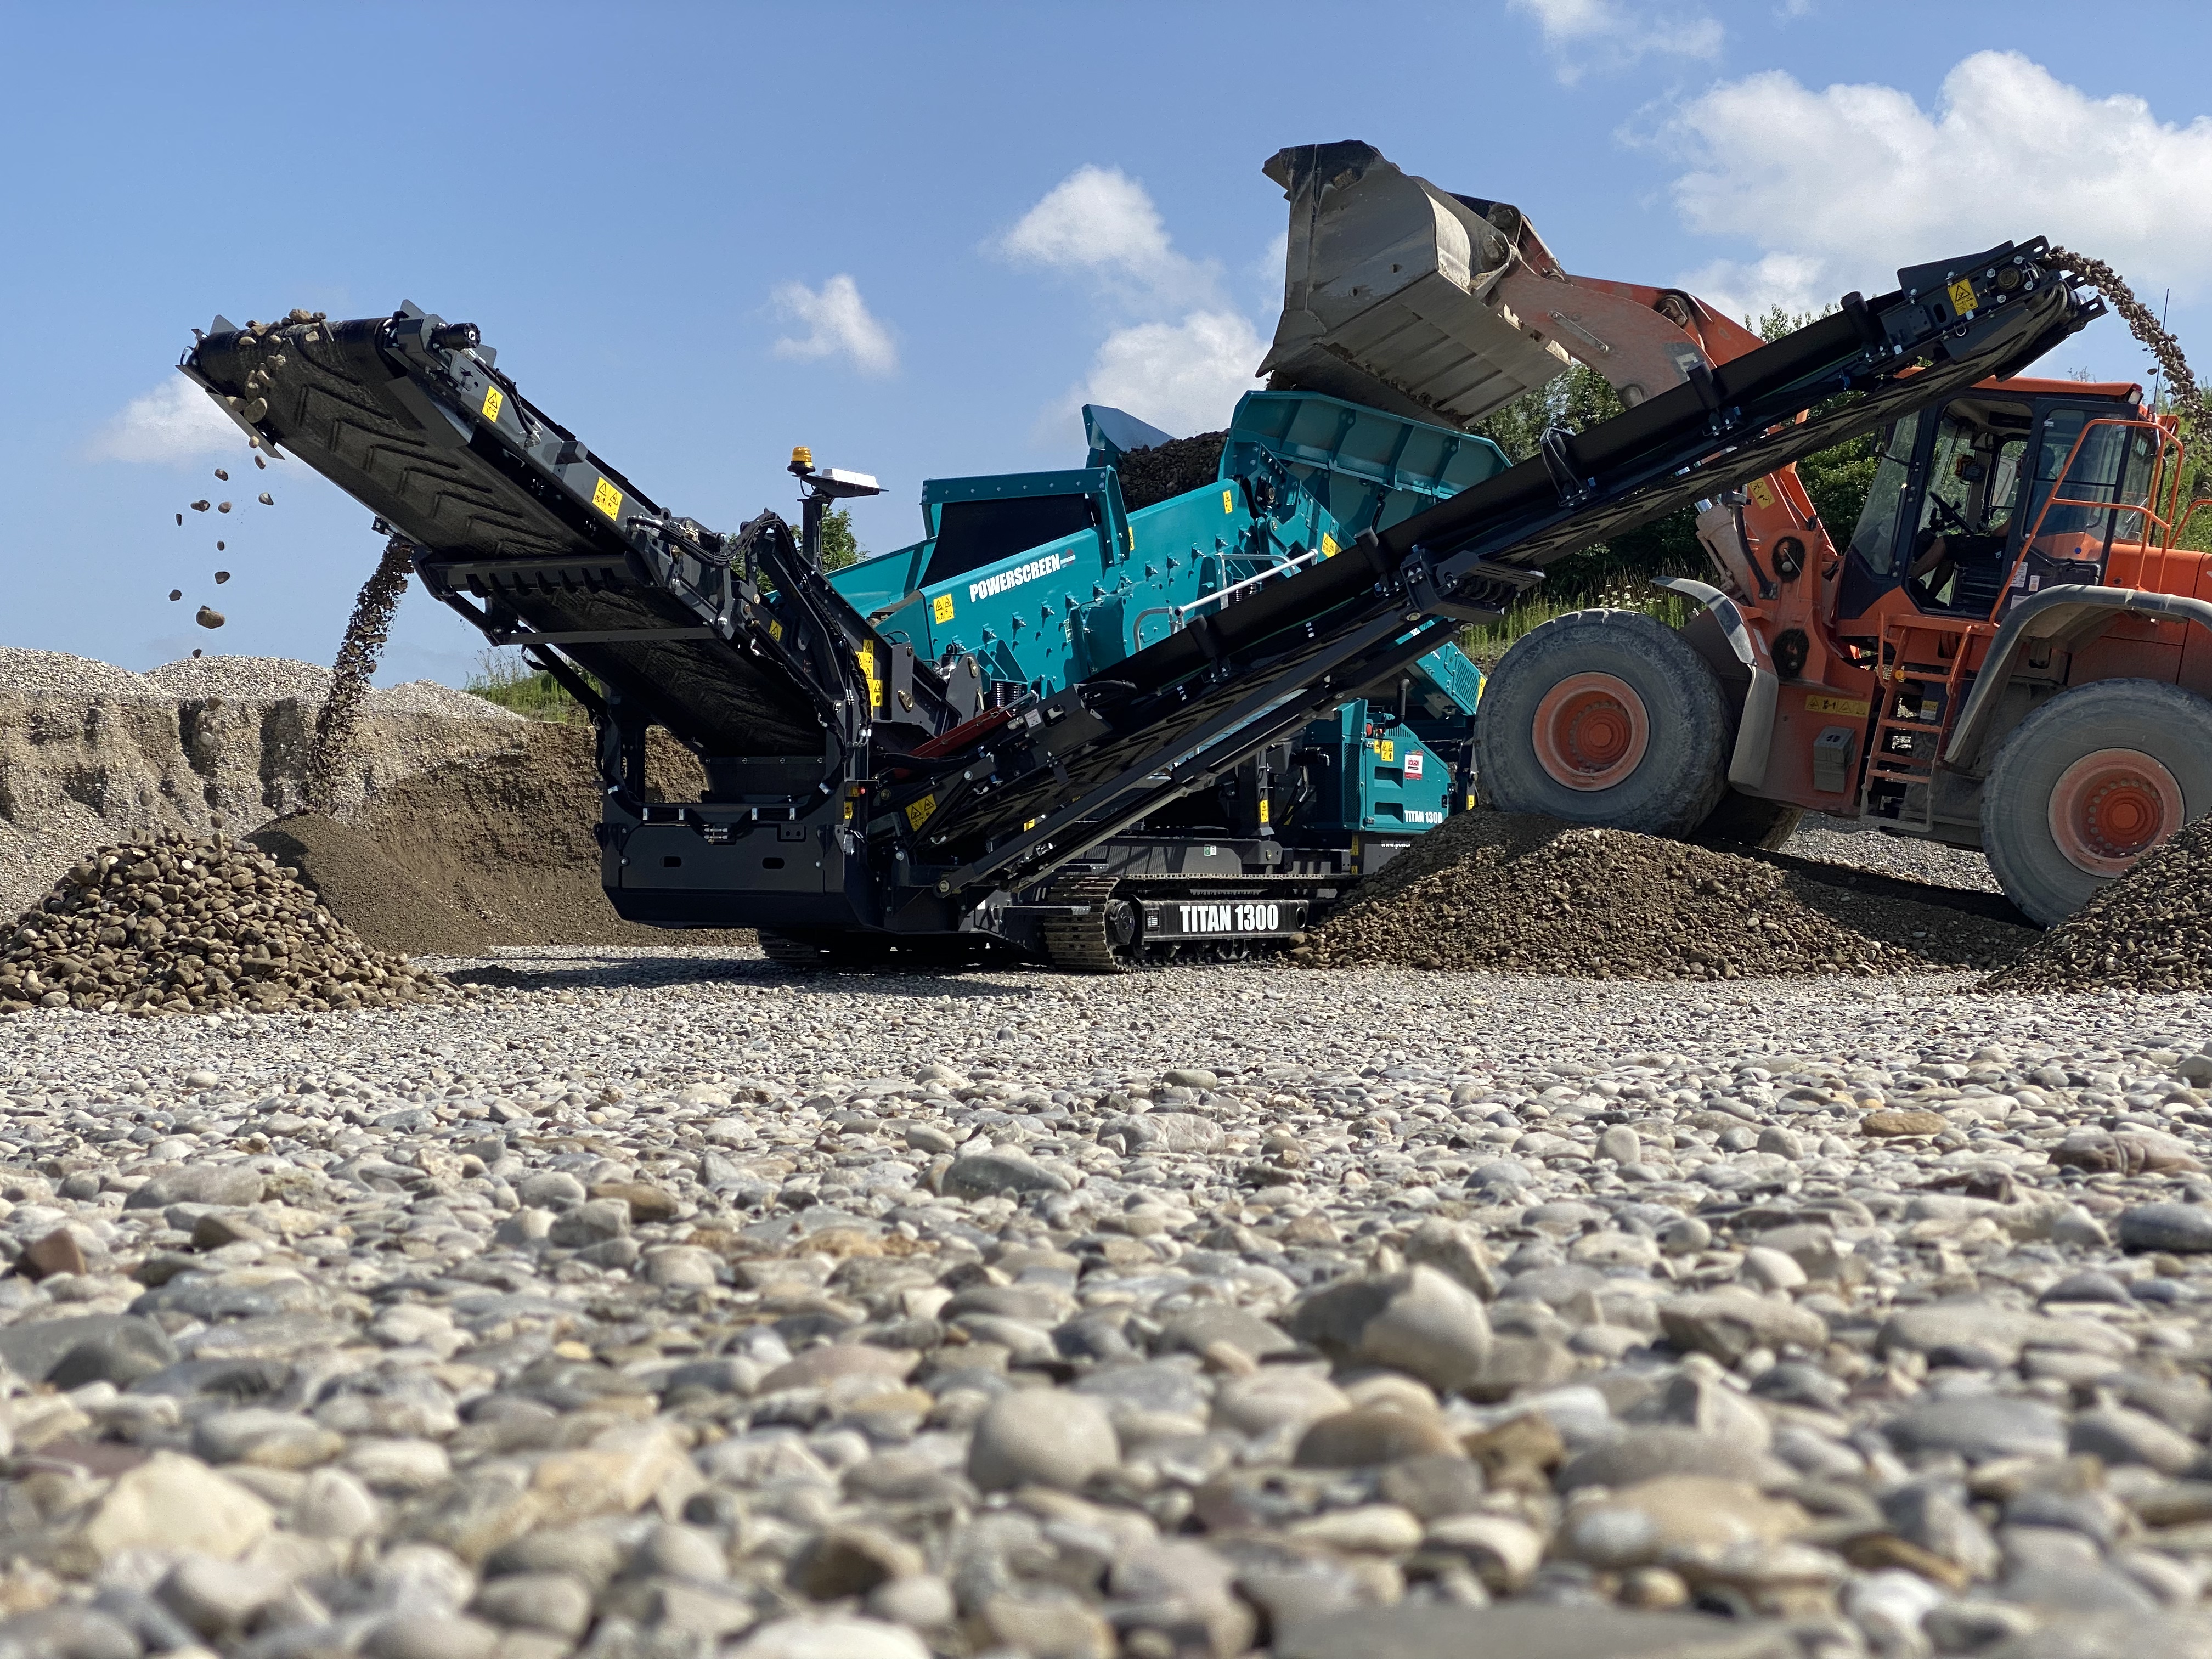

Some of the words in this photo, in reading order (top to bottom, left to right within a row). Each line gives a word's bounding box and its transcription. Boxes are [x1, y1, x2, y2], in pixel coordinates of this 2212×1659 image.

[969, 553, 1060, 603] POWERSCREEN
[1404, 810, 1424, 823] TITAN
[1425, 812, 1443, 824] 1300
[1180, 905, 1231, 932] TITAN
[1235, 904, 1278, 931] 1300
